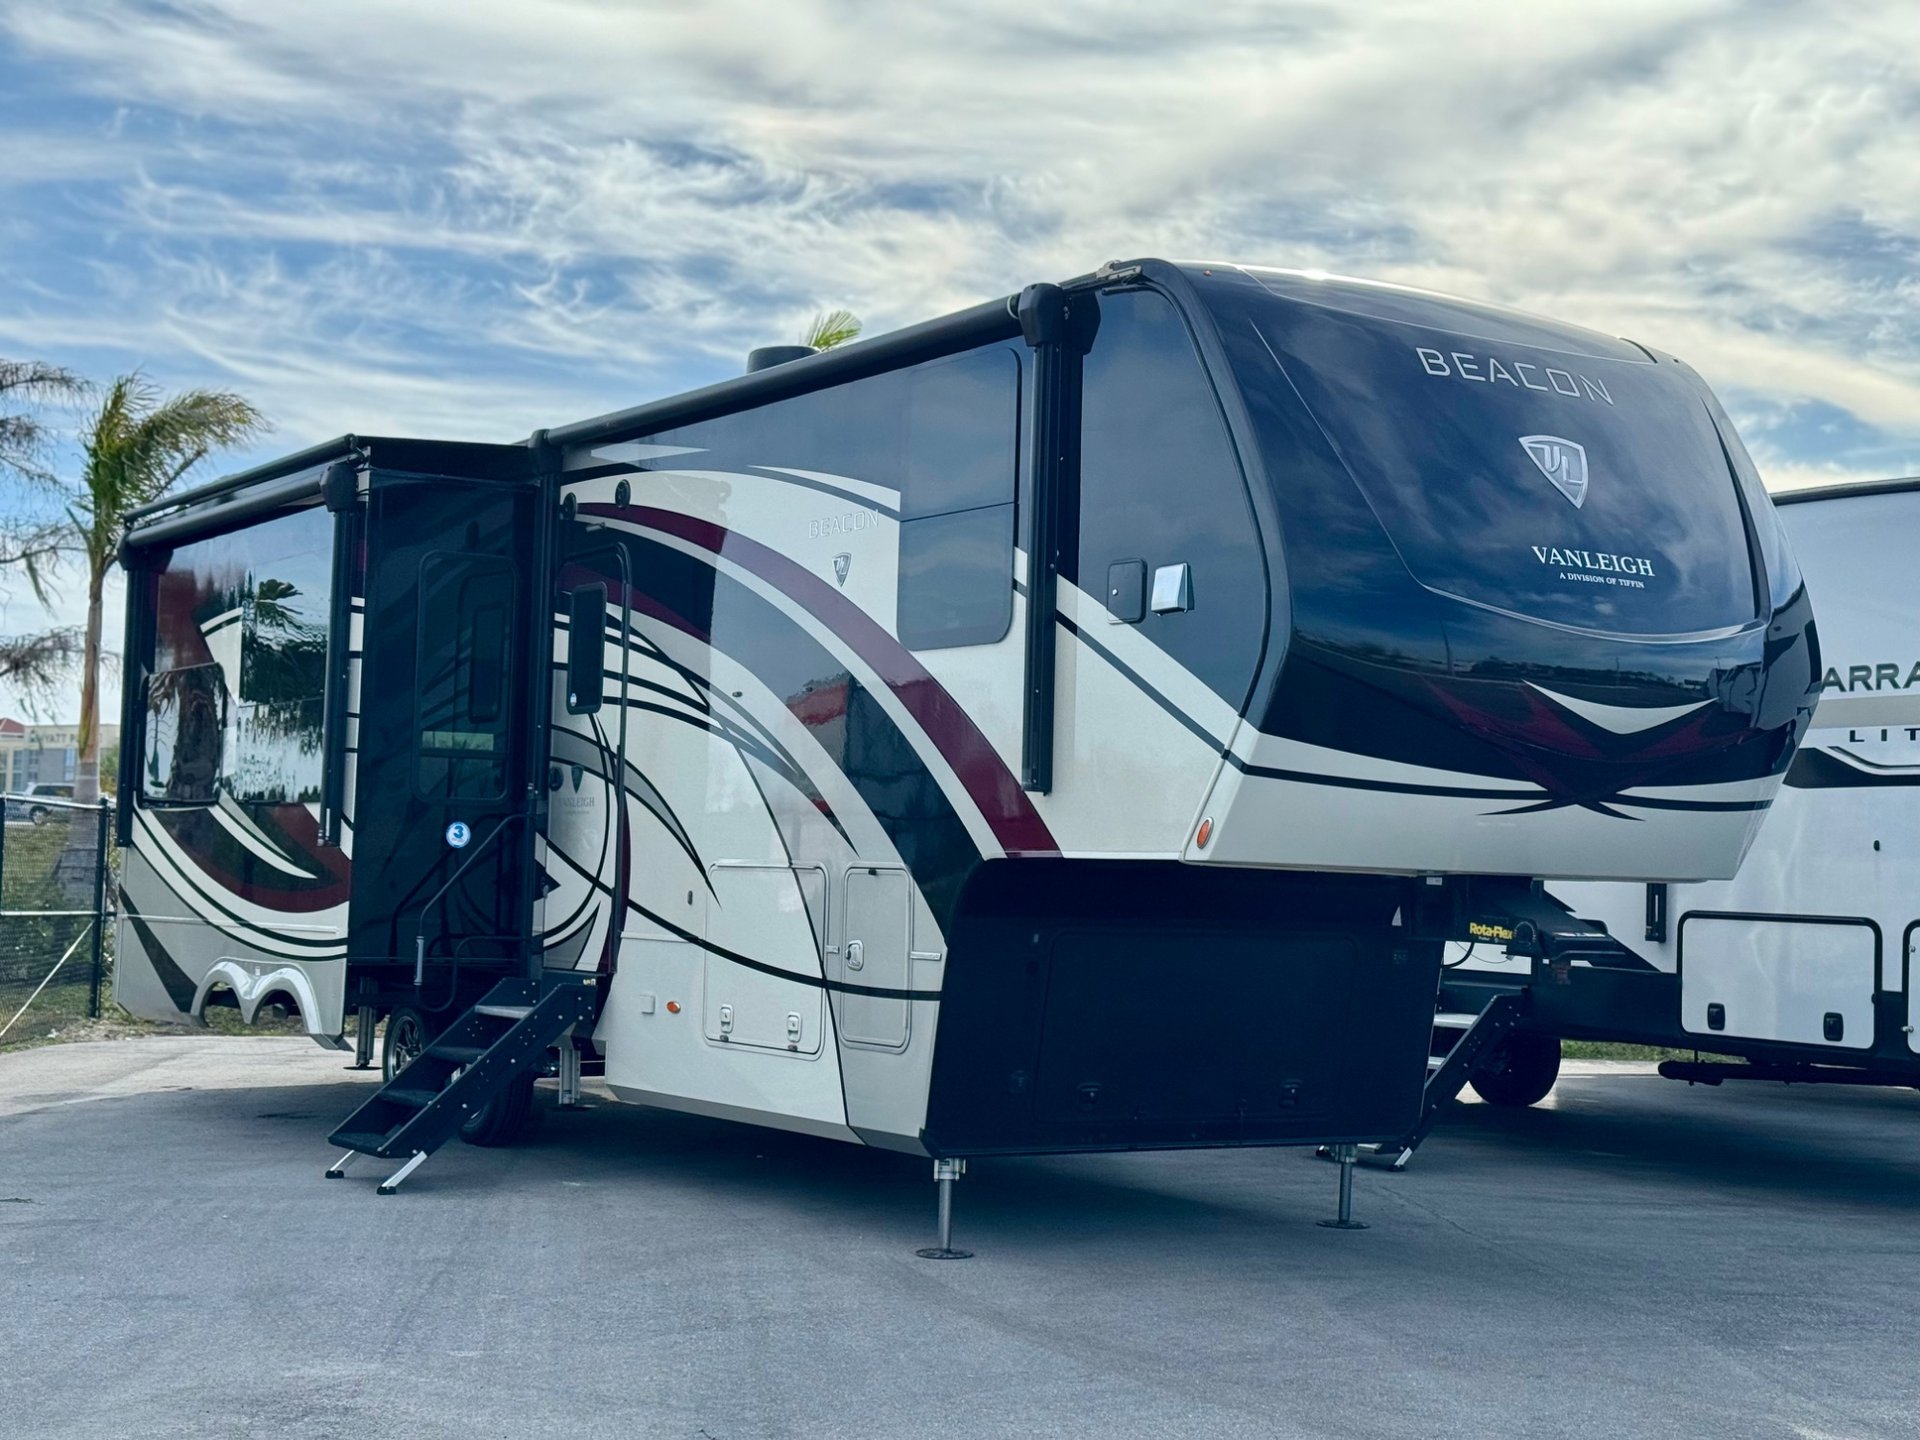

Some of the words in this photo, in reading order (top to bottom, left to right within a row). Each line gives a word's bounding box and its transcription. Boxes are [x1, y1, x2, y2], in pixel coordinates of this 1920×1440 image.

[1415, 347, 1615, 406] BEACON
[808, 509, 880, 539] BEACON
[1532, 546, 1655, 576] VANLEIGH
[1567, 573, 1605, 583] DIVISION
[1605, 577, 1617, 585] OF
[1618, 578, 1645, 588] TIFFIN
[453, 825, 464, 839] 3
[1469, 922, 1513, 940] Rota-Flex
